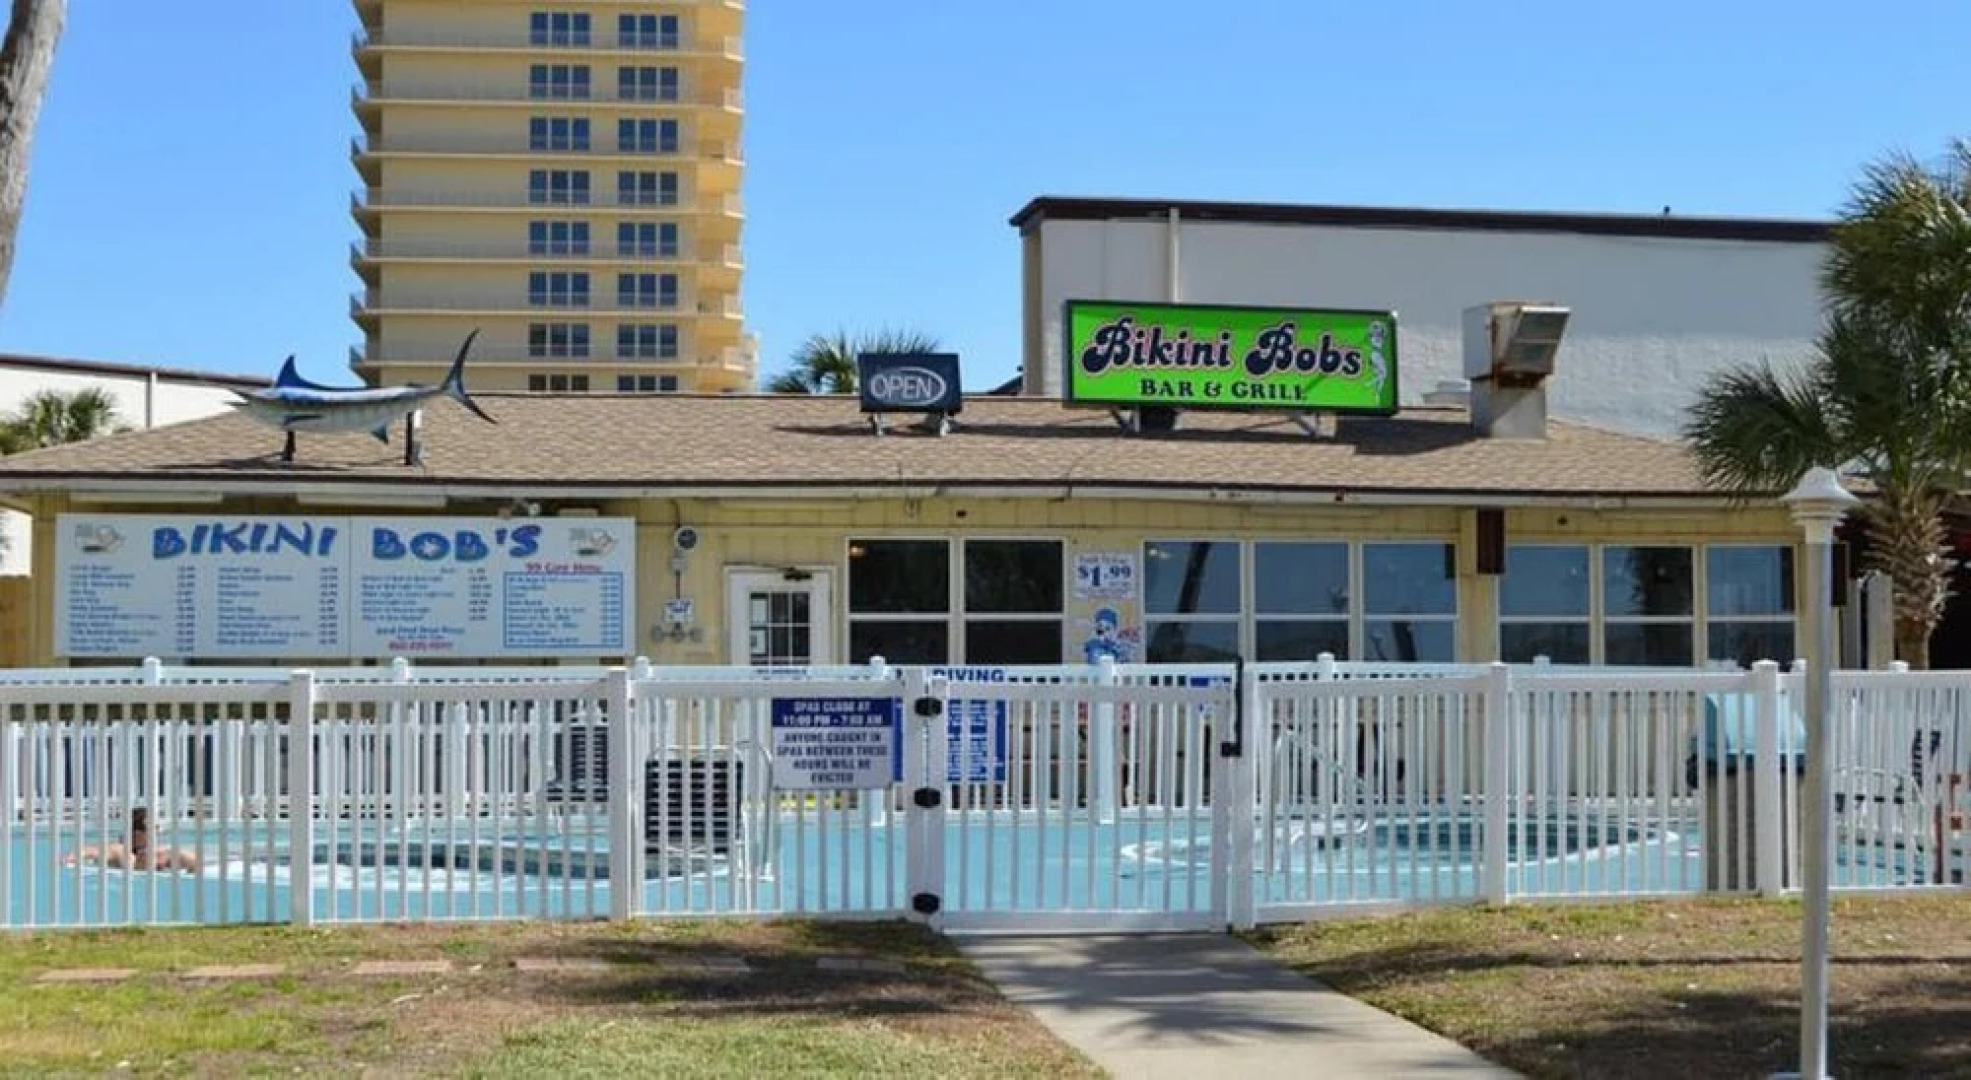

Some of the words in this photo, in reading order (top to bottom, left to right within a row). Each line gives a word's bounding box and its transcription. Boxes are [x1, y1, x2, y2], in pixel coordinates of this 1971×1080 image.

[1081, 317, 1232, 374] Bikini
[1245, 322, 1361, 377] Bobs
[870, 367, 934, 400] OPEN
[1139, 379, 1197, 398] BAR
[1204, 381, 1221, 399] &
[1231, 381, 1308, 401] GRILL
[153, 521, 337, 559] BIKINI
[373, 525, 542, 562] BOB'S
[932, 668, 1004, 681] DIVING
[794, 701, 820, 712] SPAS
[823, 701, 853, 712] CLOSE
[857, 701, 870, 712] AT
[814, 715, 831, 726] PM
[866, 715, 883, 726] AM
[784, 732, 824, 742] ANYONE
[828, 732, 868, 742] CAUGHT
[871, 732, 881, 742] IN
[806, 746, 854, 756] BETWEEN
[857, 746, 888, 756] THESE
[793, 759, 828, 769] HOURS
[831, 759, 856, 769] WILL
[858, 759, 871, 769] BE
[811, 773, 854, 784] EVICTED
